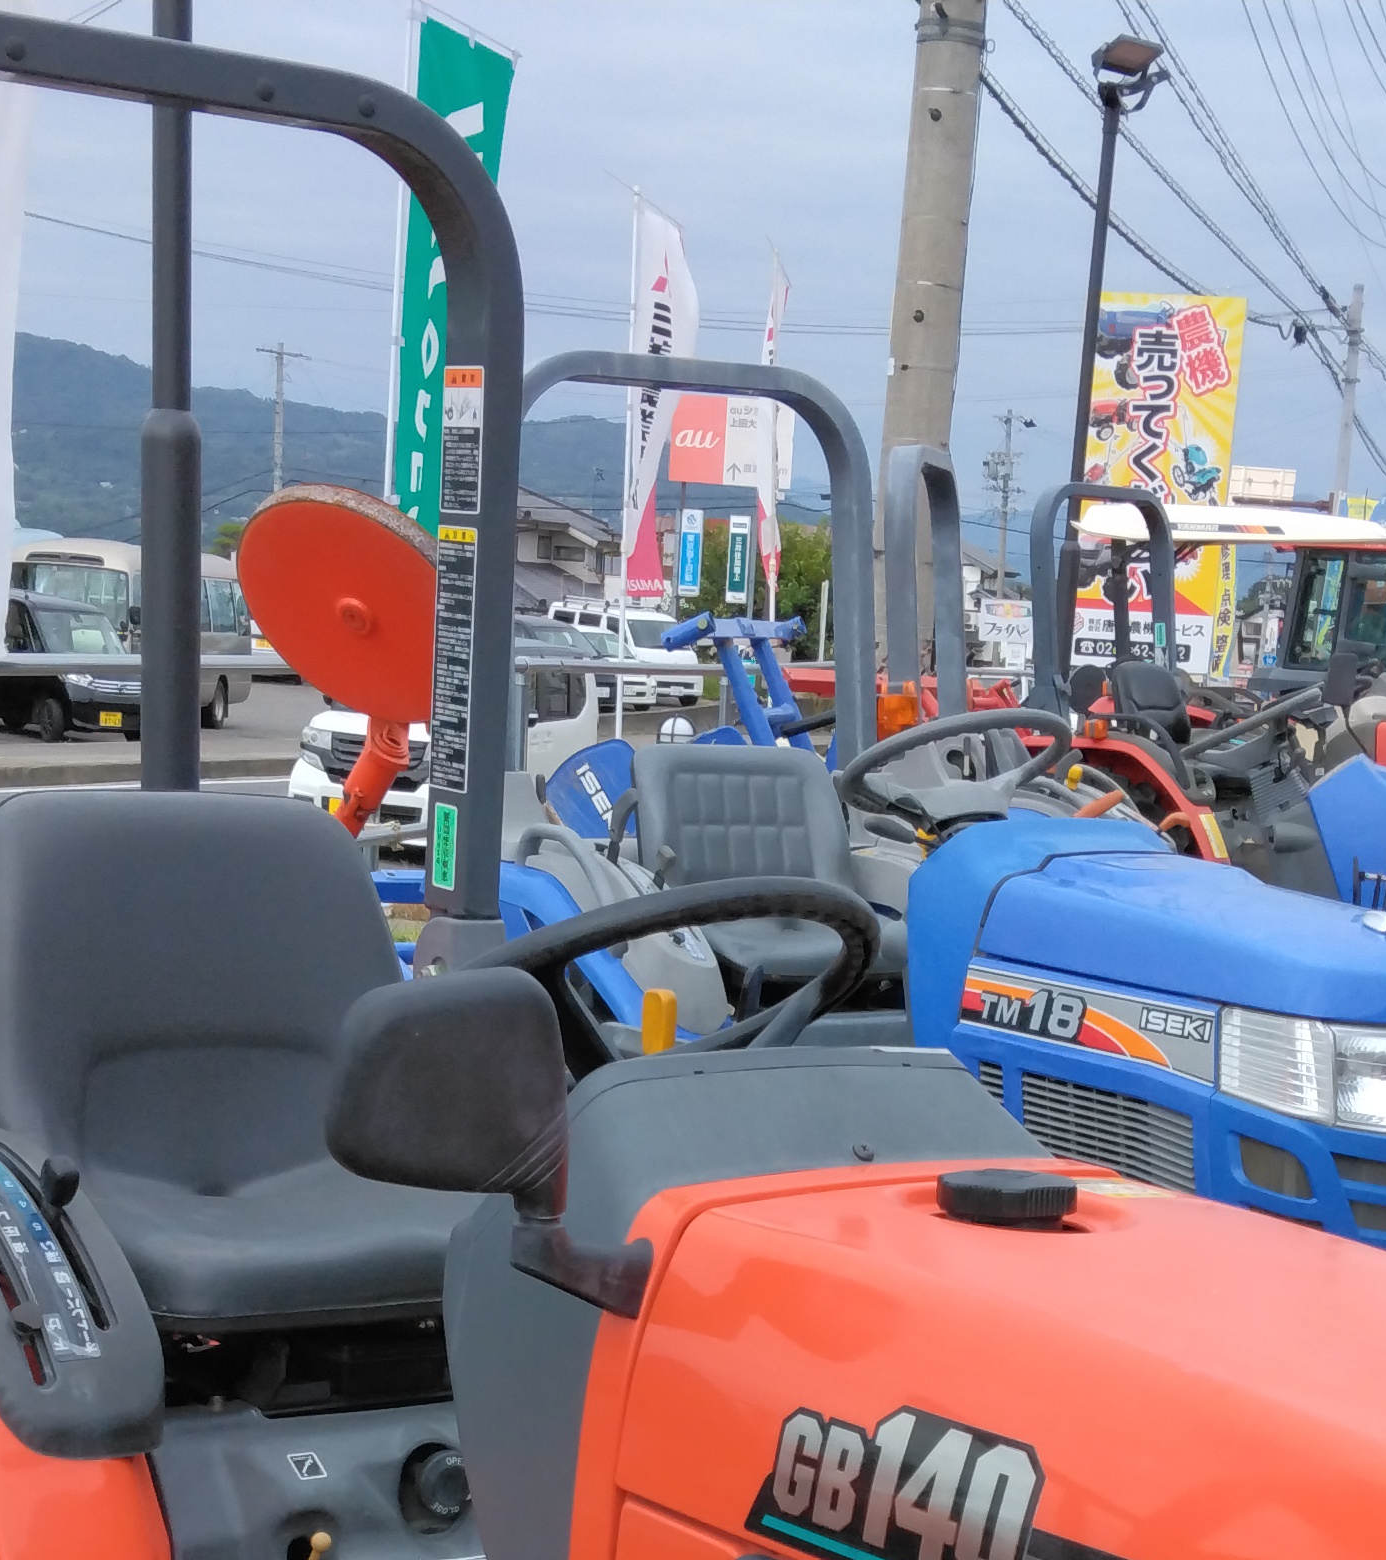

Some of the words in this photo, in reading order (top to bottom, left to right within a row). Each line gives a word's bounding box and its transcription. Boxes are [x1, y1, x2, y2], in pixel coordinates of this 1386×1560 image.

[1175, 310, 1226, 391] 農機
[675, 428, 721, 449] au
[980, 989, 1085, 1040] TM18
[1140, 1008, 1212, 1042] ISEKI
